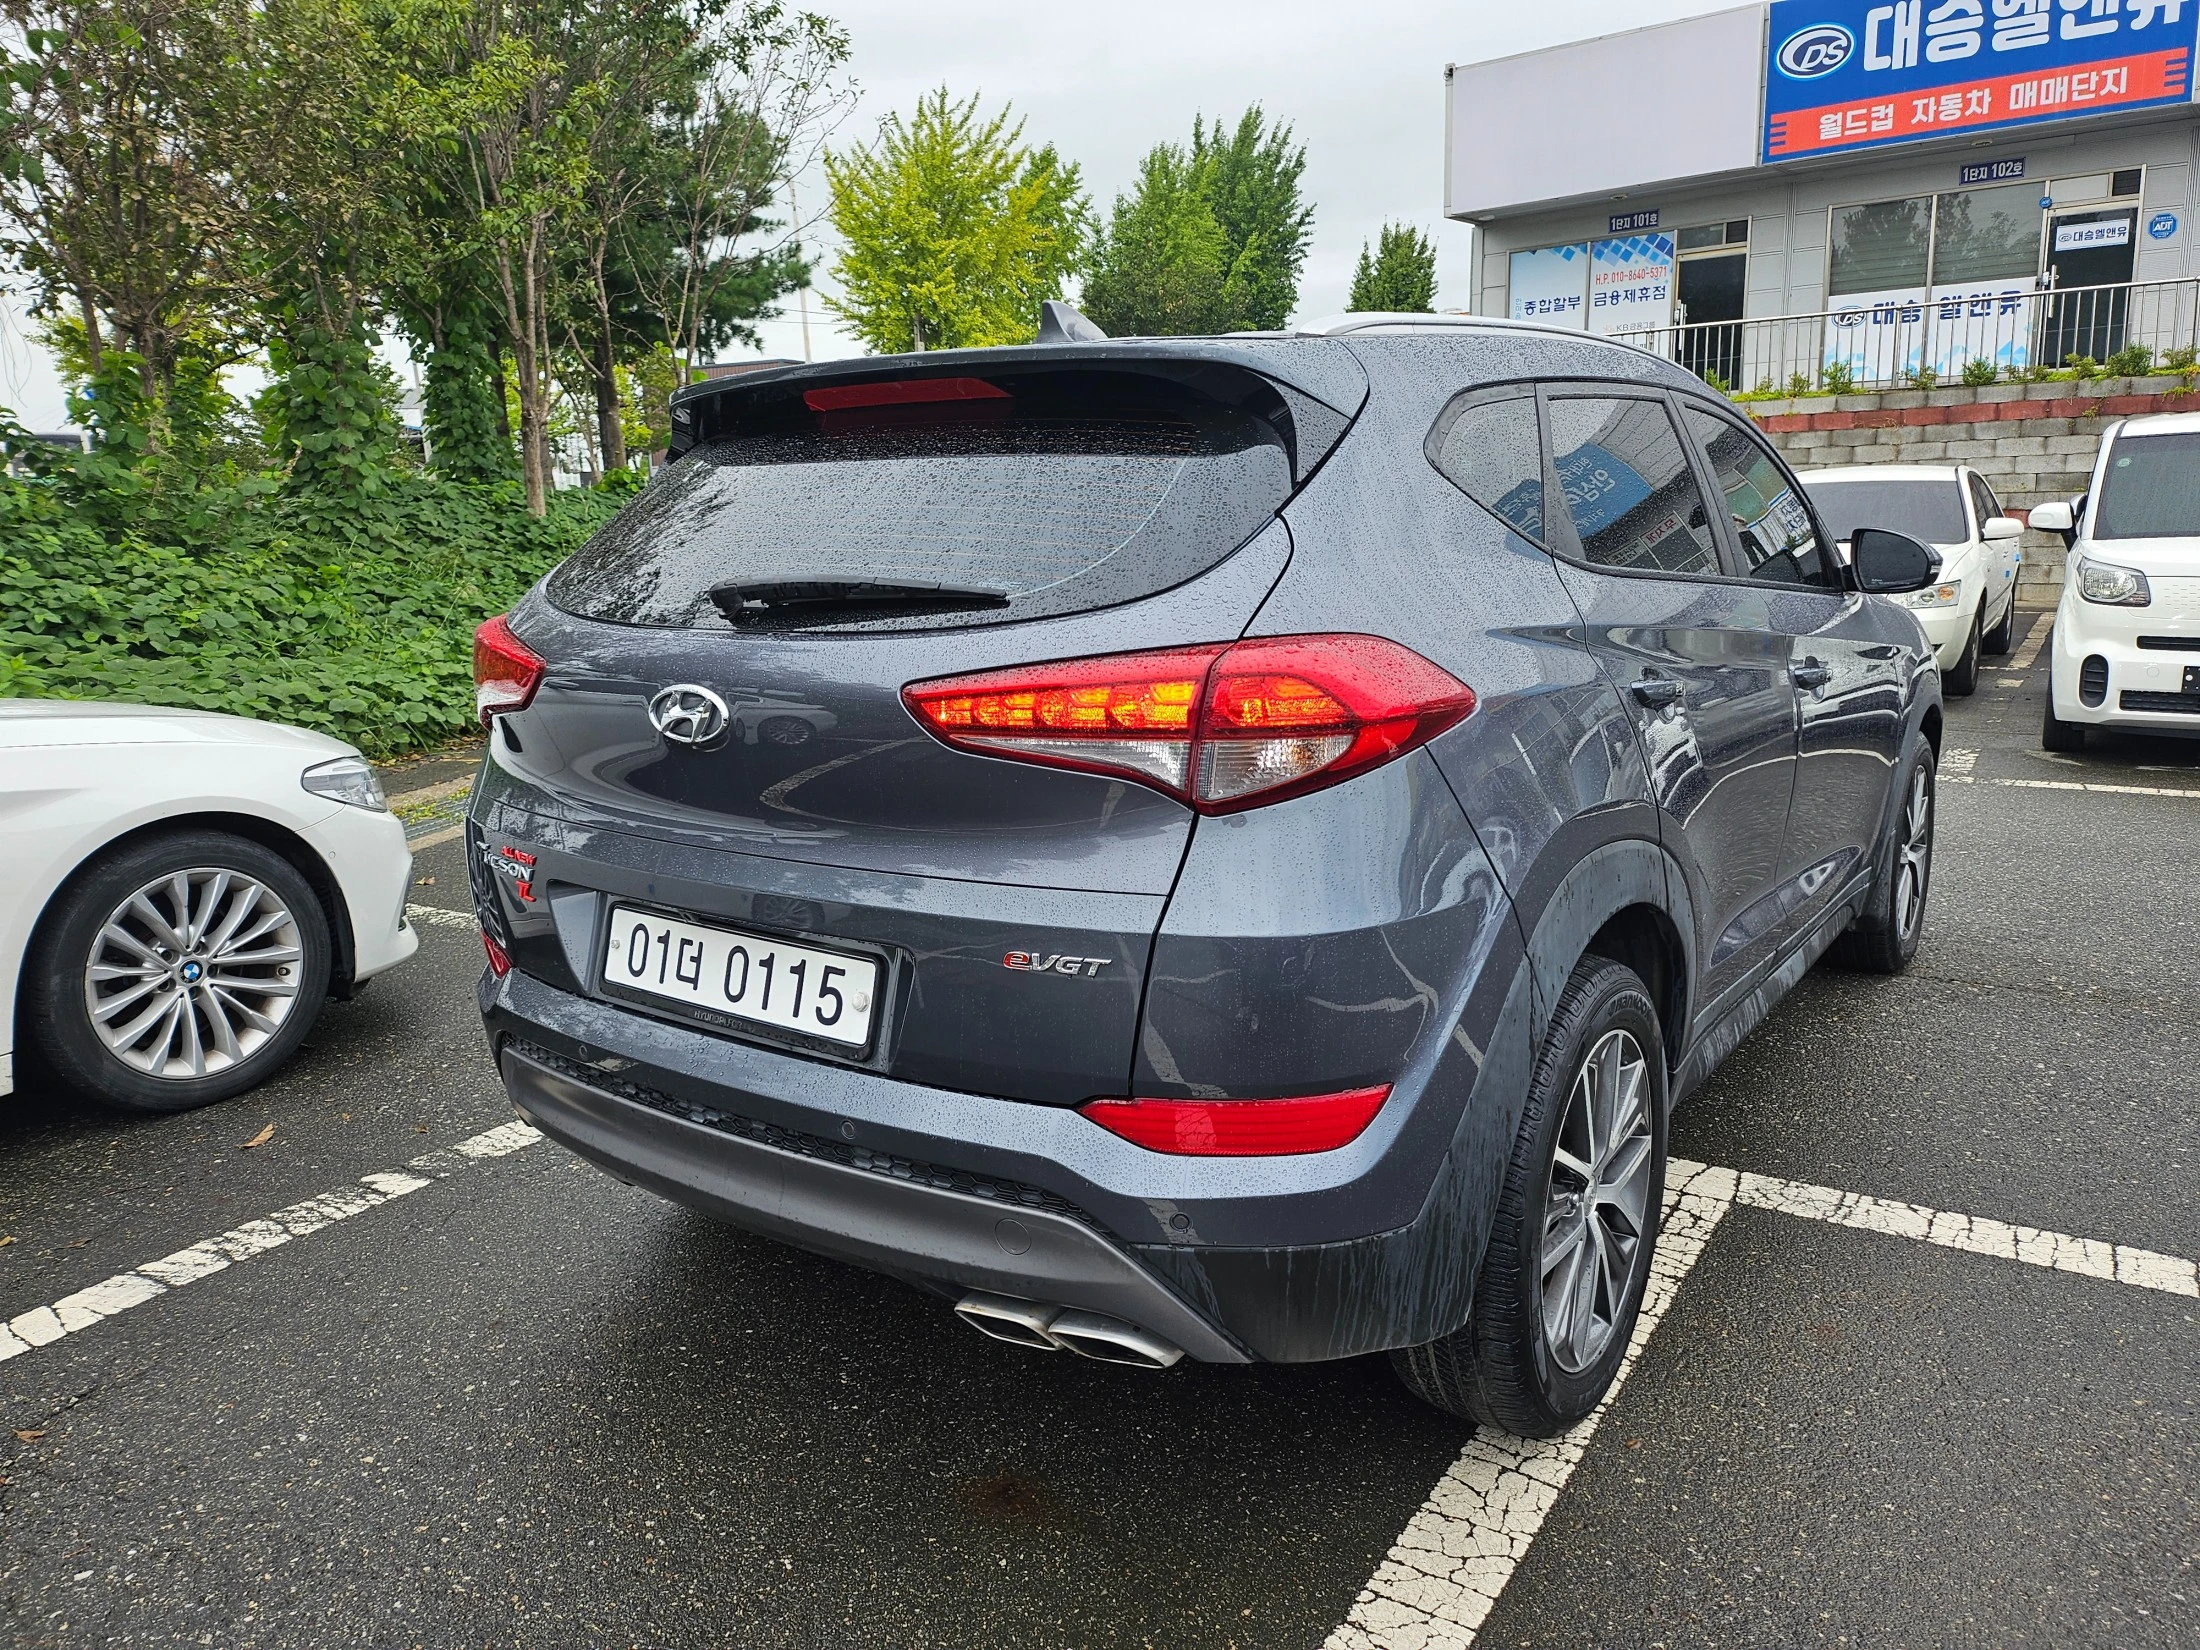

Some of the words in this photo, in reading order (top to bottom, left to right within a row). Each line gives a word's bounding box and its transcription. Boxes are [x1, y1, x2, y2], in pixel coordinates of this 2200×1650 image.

[1819, 103, 1894, 141] 월드컵
[1910, 87, 1992, 125] 자동차
[2009, 66, 2128, 111] 매매단지
[1963, 167, 1988, 182] 1단지
[1991, 161, 2023, 178] 102호
[1611, 217, 1631, 231] 1단지
[1633, 212, 1658, 227] 101호
[2153, 221, 2173, 232] ADT
[2073, 226, 2127, 241] 대승엘앤유
[1524, 296, 1581, 316] 종합할부
[1594, 285, 1667, 307] 금융제휴점
[627, 922, 704, 991] 01더
[723, 944, 846, 1026] 0115
[1002, 950, 1112, 977] eVGT
